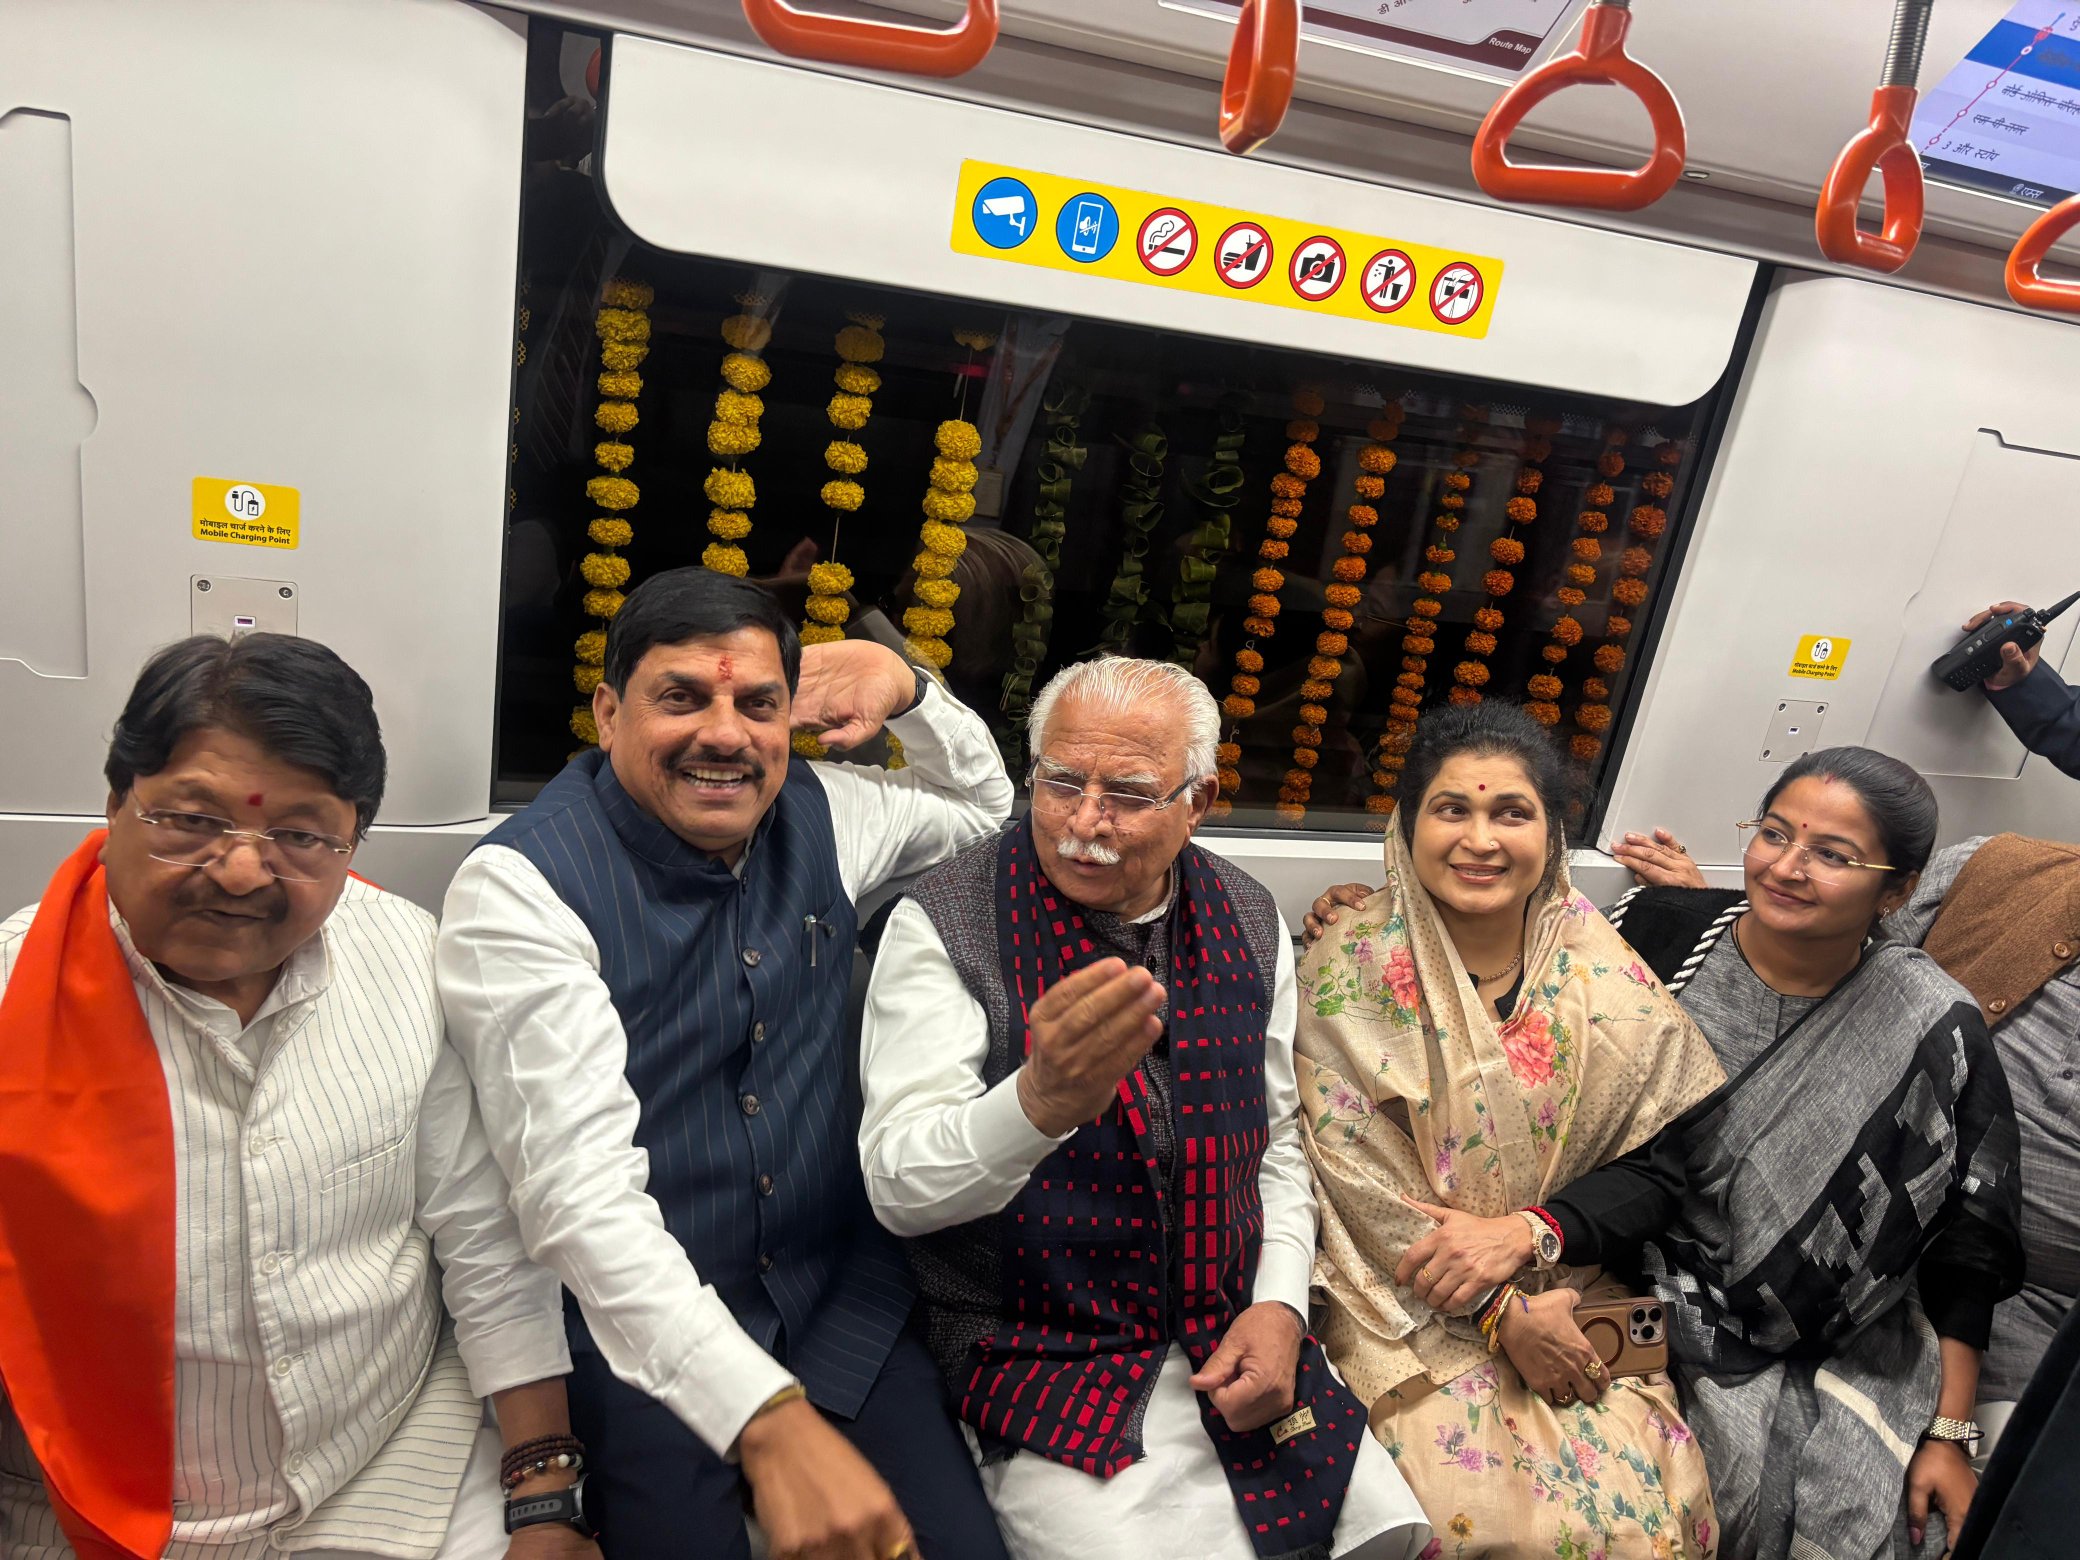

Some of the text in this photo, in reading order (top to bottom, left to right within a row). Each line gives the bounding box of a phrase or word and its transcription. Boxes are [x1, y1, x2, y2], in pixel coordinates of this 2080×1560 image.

[1489, 37, 1532, 54] Route Map
[1953, 143, 1974, 155] और
[200, 518, 228, 529] मोबाइल
[248, 524, 265, 533] करने
[267, 525, 274, 533] के
[276, 526, 290, 536] लिए
[200, 529, 290, 544] Mobile Charging Point
